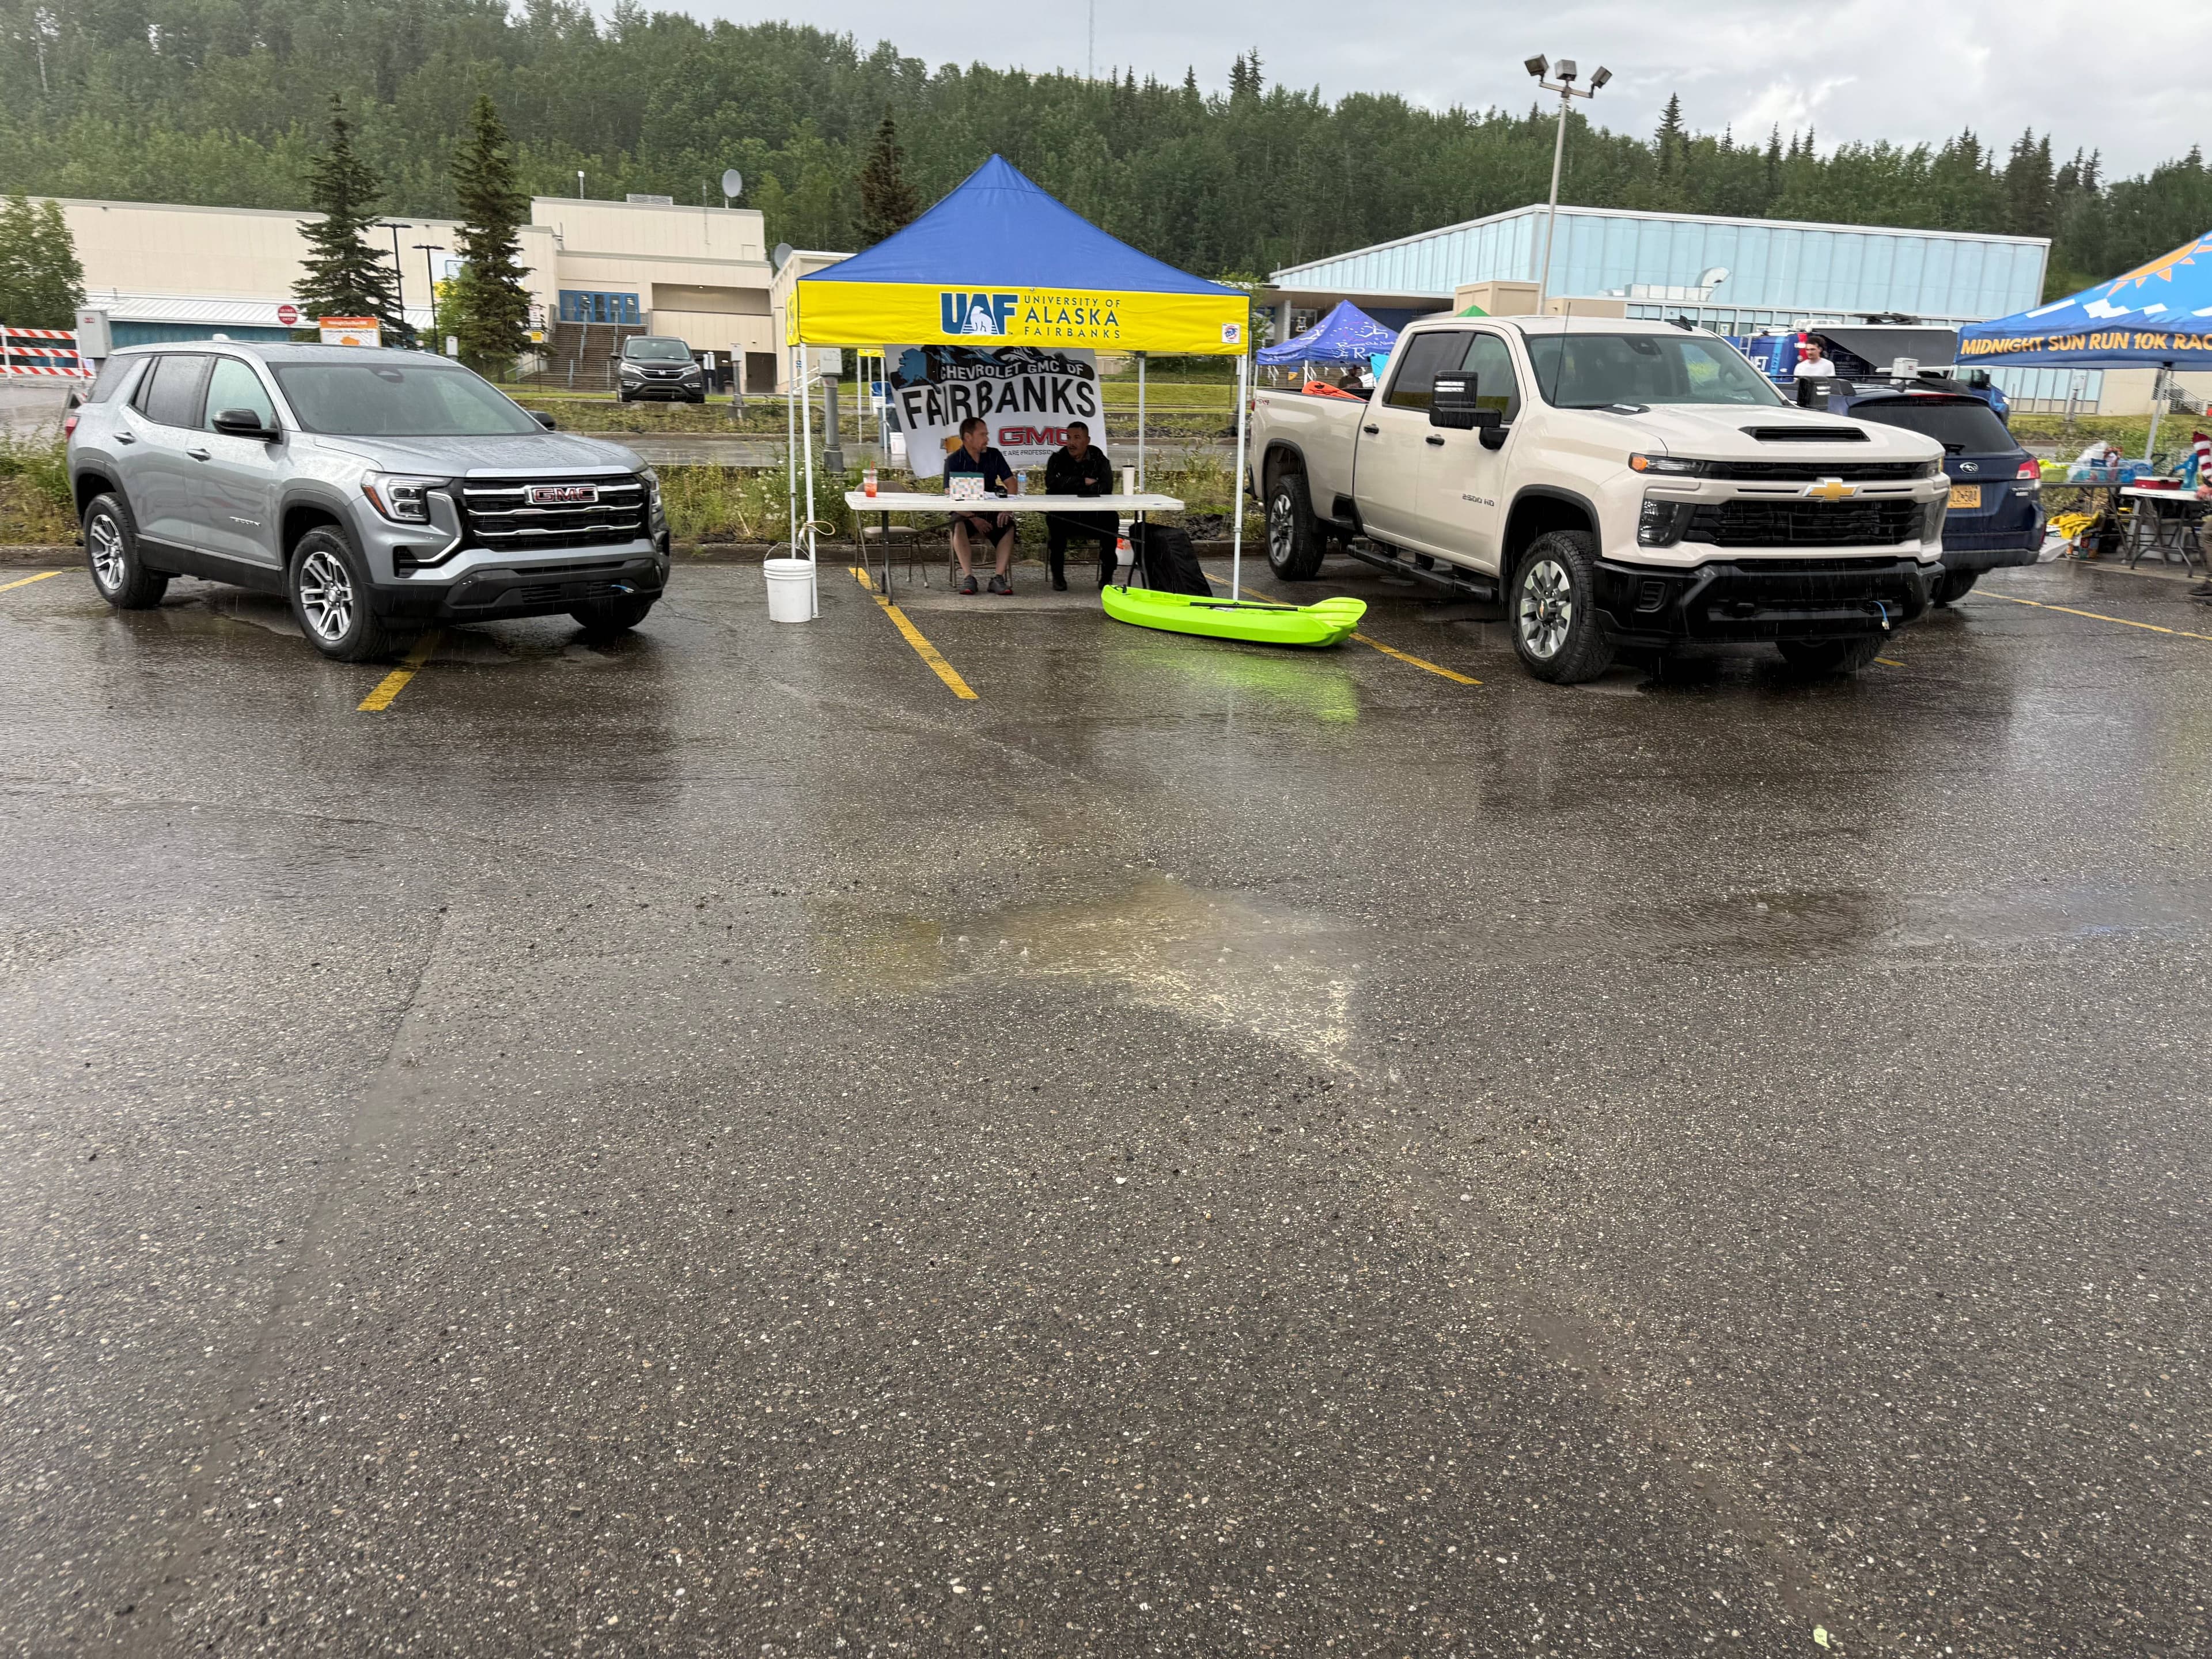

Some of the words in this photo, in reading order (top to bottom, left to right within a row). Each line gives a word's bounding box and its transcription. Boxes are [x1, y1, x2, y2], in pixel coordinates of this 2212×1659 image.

[1024, 296, 1098, 306] UNIVERSITY
[1105, 299, 1120, 307] OF
[940, 293, 1018, 335] UAF
[1025, 306, 1119, 327] ALASKA
[1024, 327, 1120, 339] FAIRBANKS
[1960, 336, 2045, 355] MIDNIGHT
[2048, 334, 2086, 351] SUN
[2088, 332, 2130, 350] RUN
[2133, 332, 2168, 350] 10K
[941, 362, 1021, 380] CHEVROLET
[1027, 360, 1060, 373] GMC
[1067, 364, 1084, 375] OF
[902, 376, 1096, 429] FAIRBANKS
[532, 487, 596, 502] GMC
[1462, 494, 1482, 503] 2500
